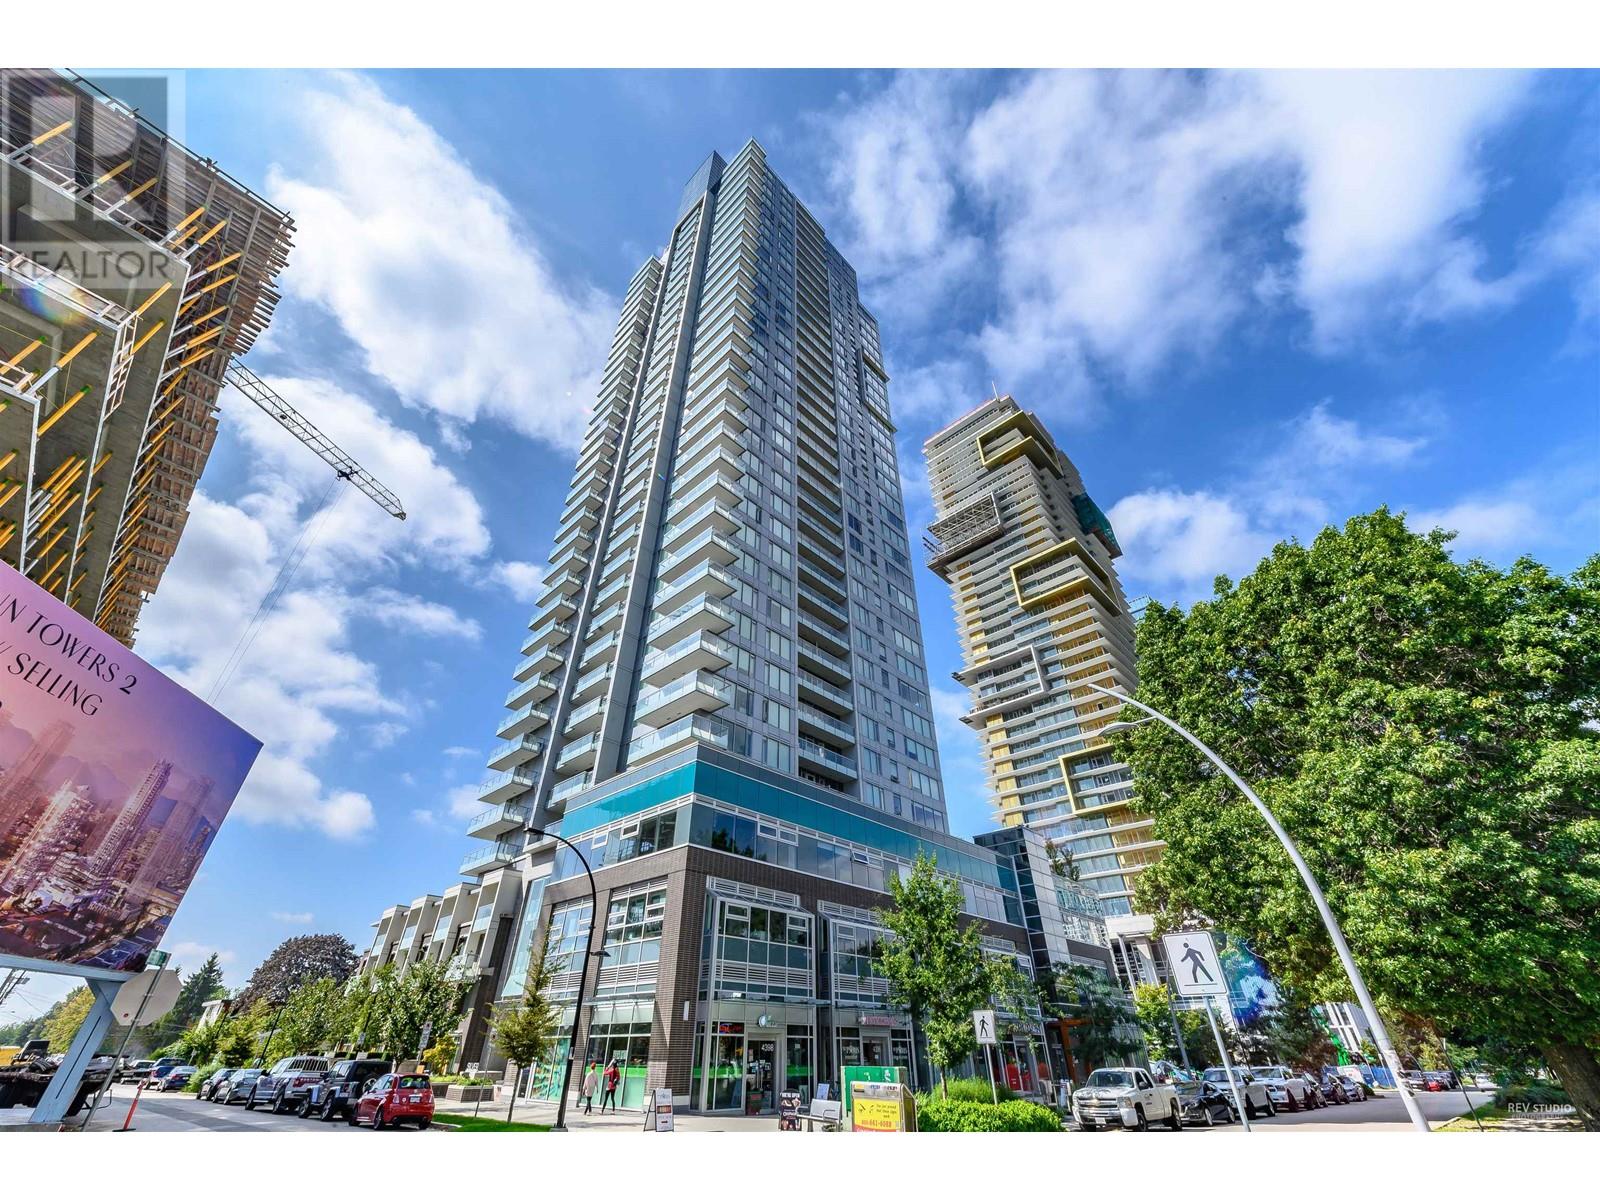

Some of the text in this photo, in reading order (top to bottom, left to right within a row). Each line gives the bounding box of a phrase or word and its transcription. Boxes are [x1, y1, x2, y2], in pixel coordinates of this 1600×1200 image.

[7, 652, 103, 716] SELLING
[27, 611, 120, 683] TOWERS
[119, 674, 137, 695] 2
